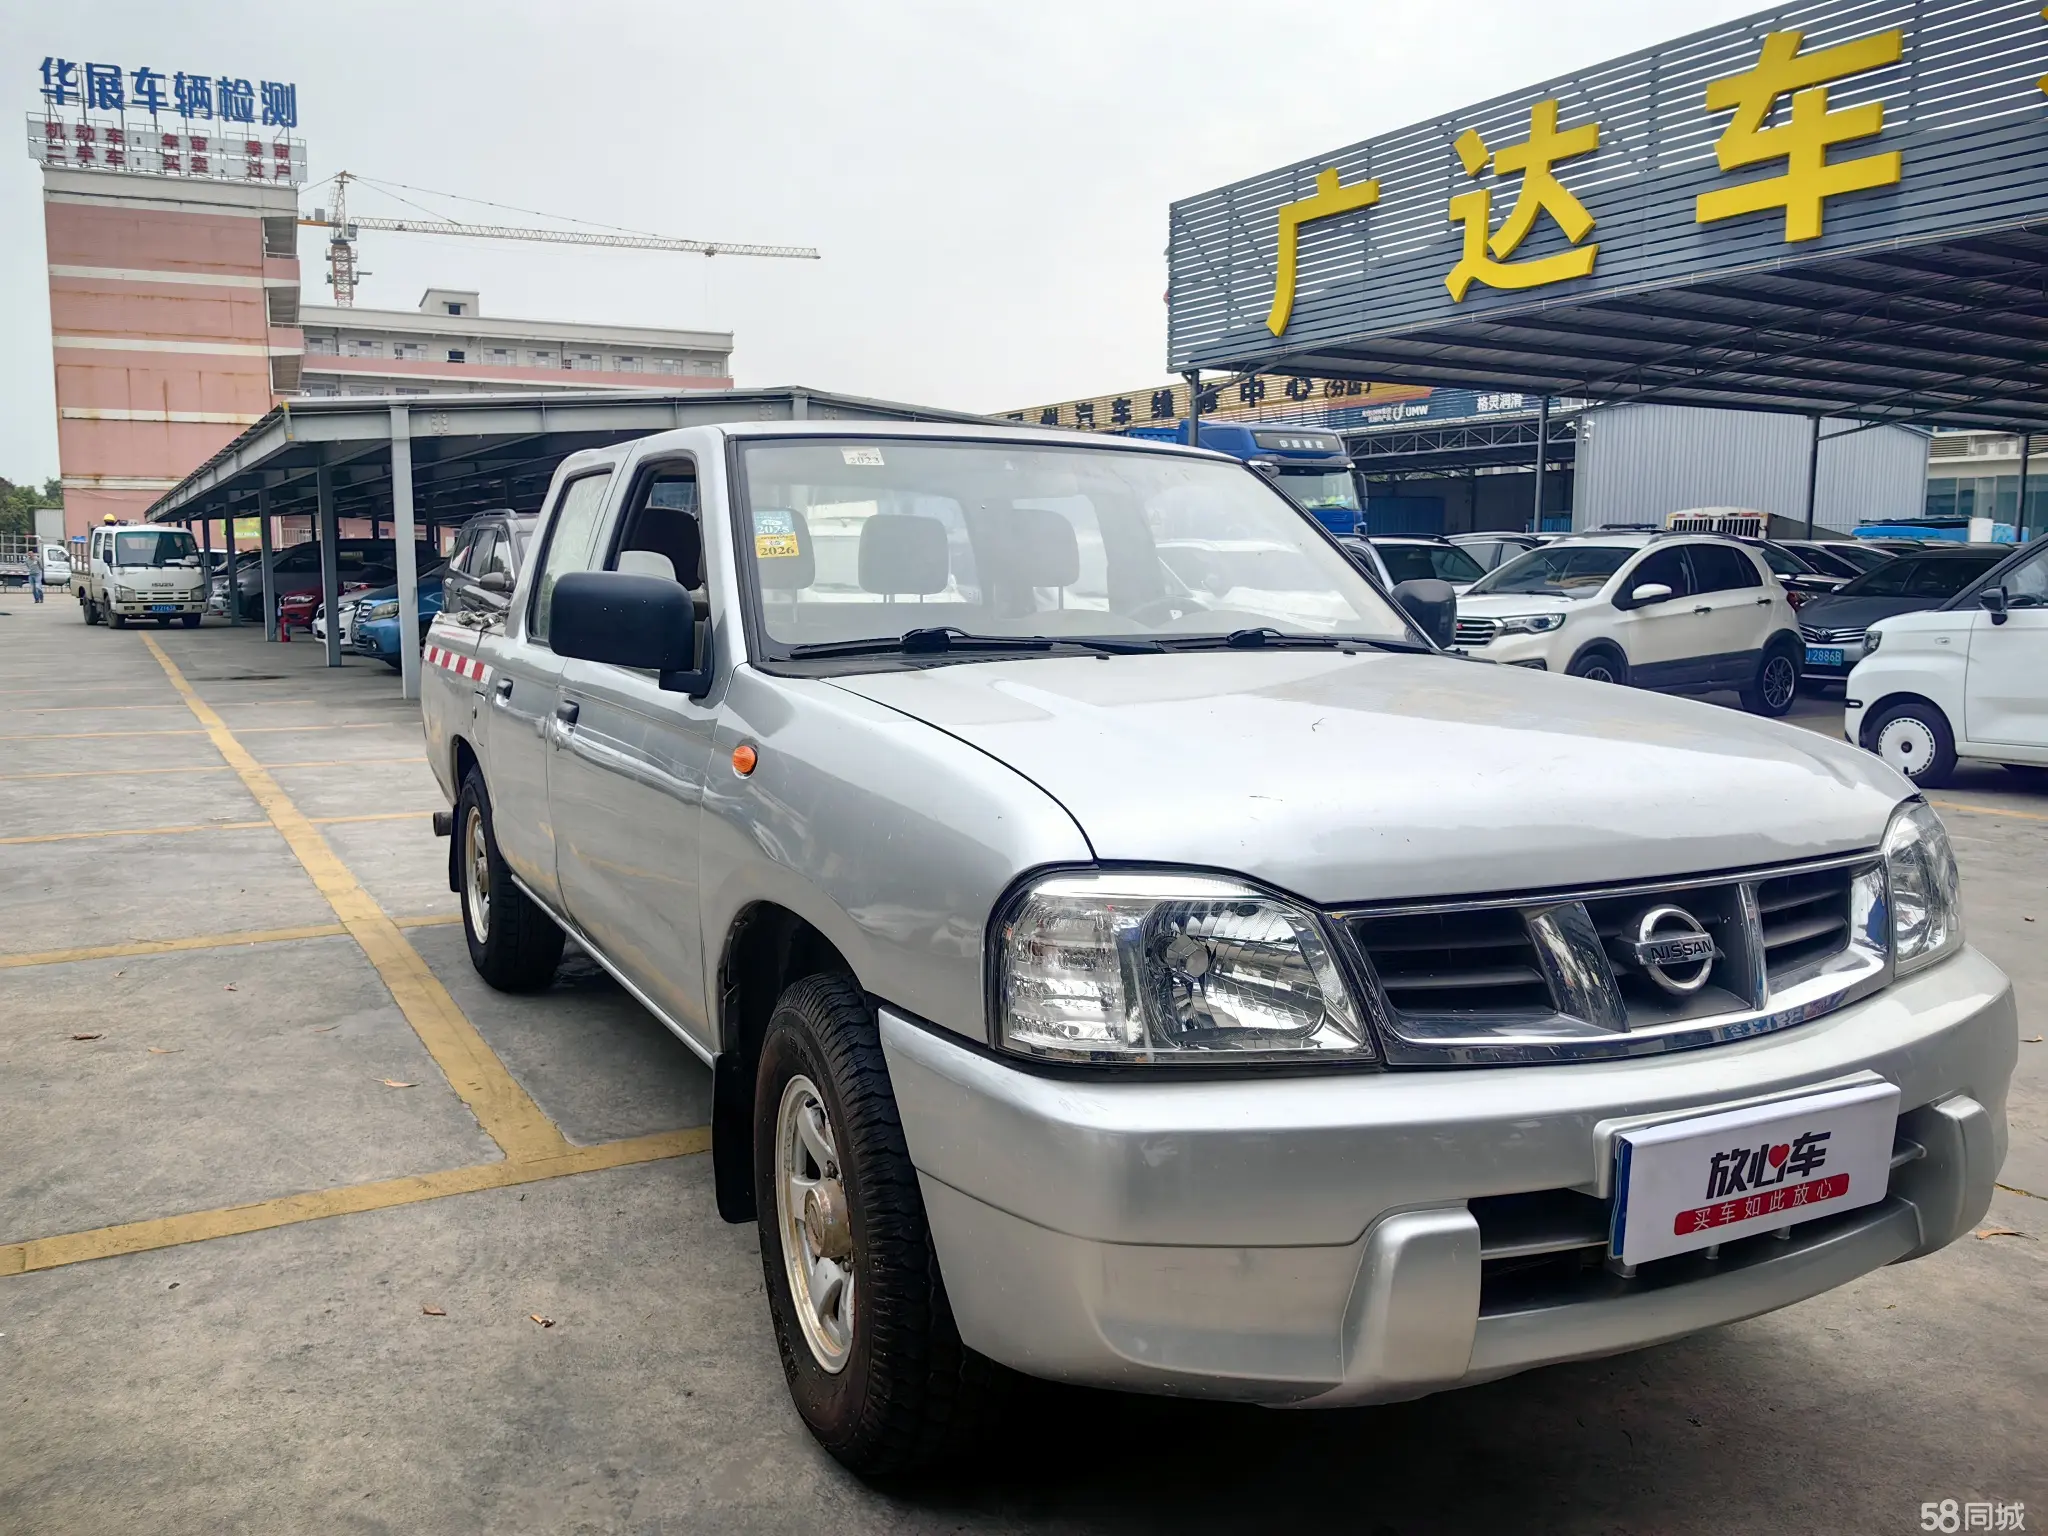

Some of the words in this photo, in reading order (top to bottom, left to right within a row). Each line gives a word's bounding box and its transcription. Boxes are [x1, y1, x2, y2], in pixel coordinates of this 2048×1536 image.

[40, 56, 298, 128] 华展车辆检测
[1266, 8, 2048, 337] 广达车
[1406, 405, 1429, 417] UMW
[760, 546, 795, 556] 2026
[1651, 940, 1712, 960] NISSAN
[1706, 1131, 1831, 1200] 放心车
[1693, 1179, 1832, 1232] 买车如此放心
